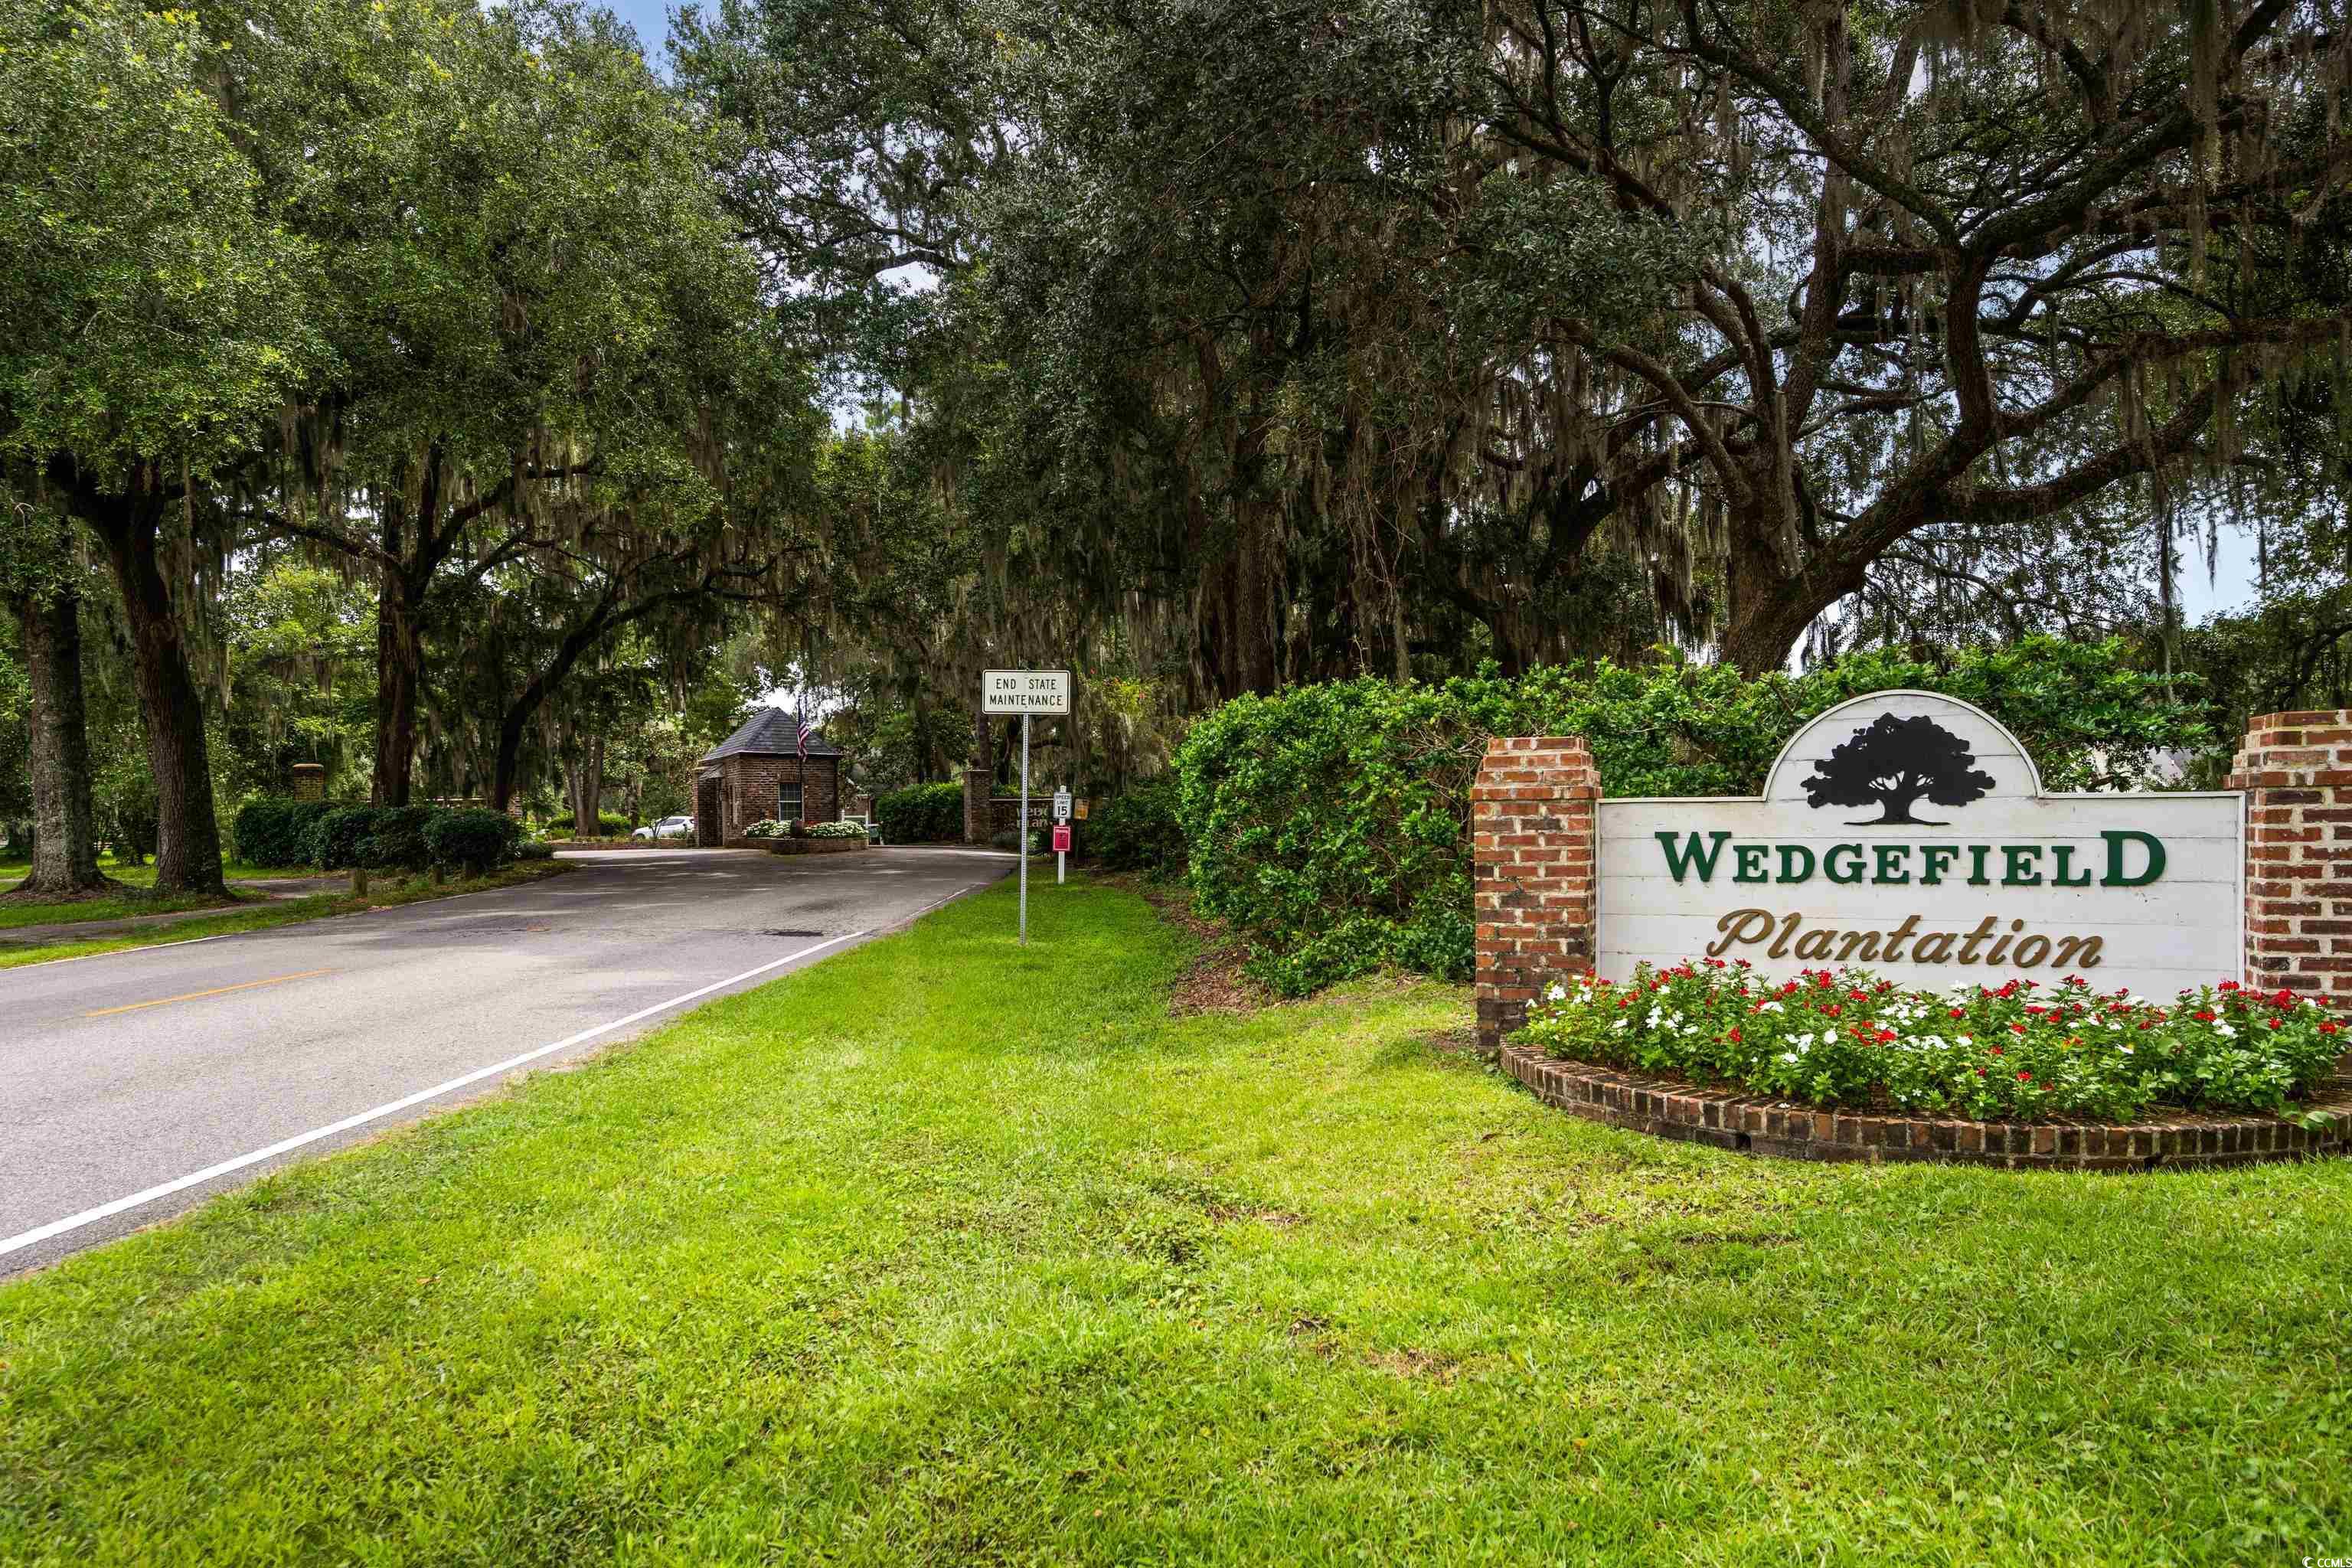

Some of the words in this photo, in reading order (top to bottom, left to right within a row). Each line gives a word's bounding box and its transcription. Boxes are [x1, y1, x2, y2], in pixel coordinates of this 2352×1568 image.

[996, 678, 1016, 690] END
[1028, 678, 1057, 690] STATE
[989, 694, 1063, 706] MAINTENANCE
[1057, 805, 1067, 815] 15
[1655, 830, 2166, 887] WEDGEFIELD
[1706, 908, 2104, 969] Plantation
